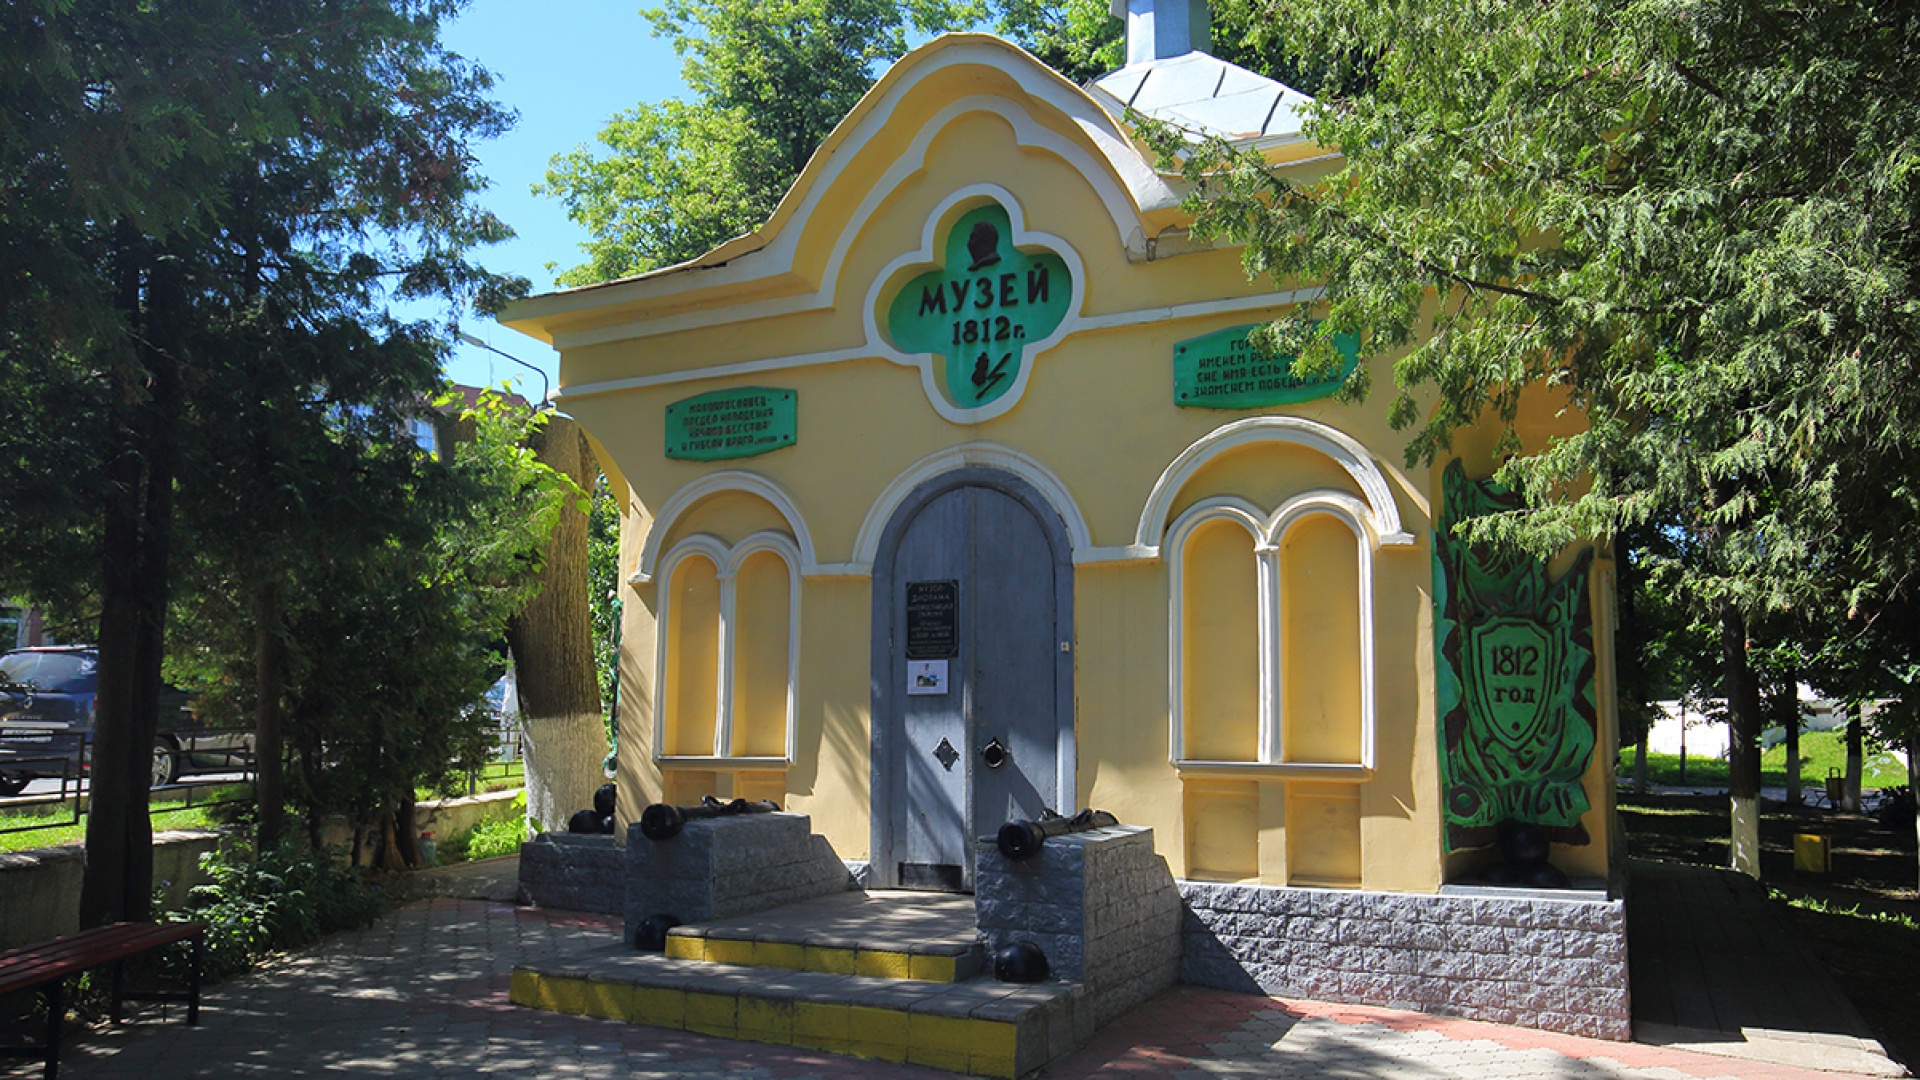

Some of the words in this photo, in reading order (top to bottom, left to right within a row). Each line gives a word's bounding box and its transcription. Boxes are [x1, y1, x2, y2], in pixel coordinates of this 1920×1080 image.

[919, 262, 1048, 317] МУЗЕЙ
[1199, 353, 1246, 368] ИМЕНЕМ
[1197, 370, 1218, 383] СИЕ
[1222, 366, 1246, 381] ИМЯ
[1251, 363, 1281, 378] ЕСТЬ
[1194, 379, 1254, 397] ЗНАМЕНЕМ
[1259, 376, 1306, 390] ПОБЕДЫ
[1490, 644, 1539, 676] 1812
[1494, 686, 1536, 704] год
